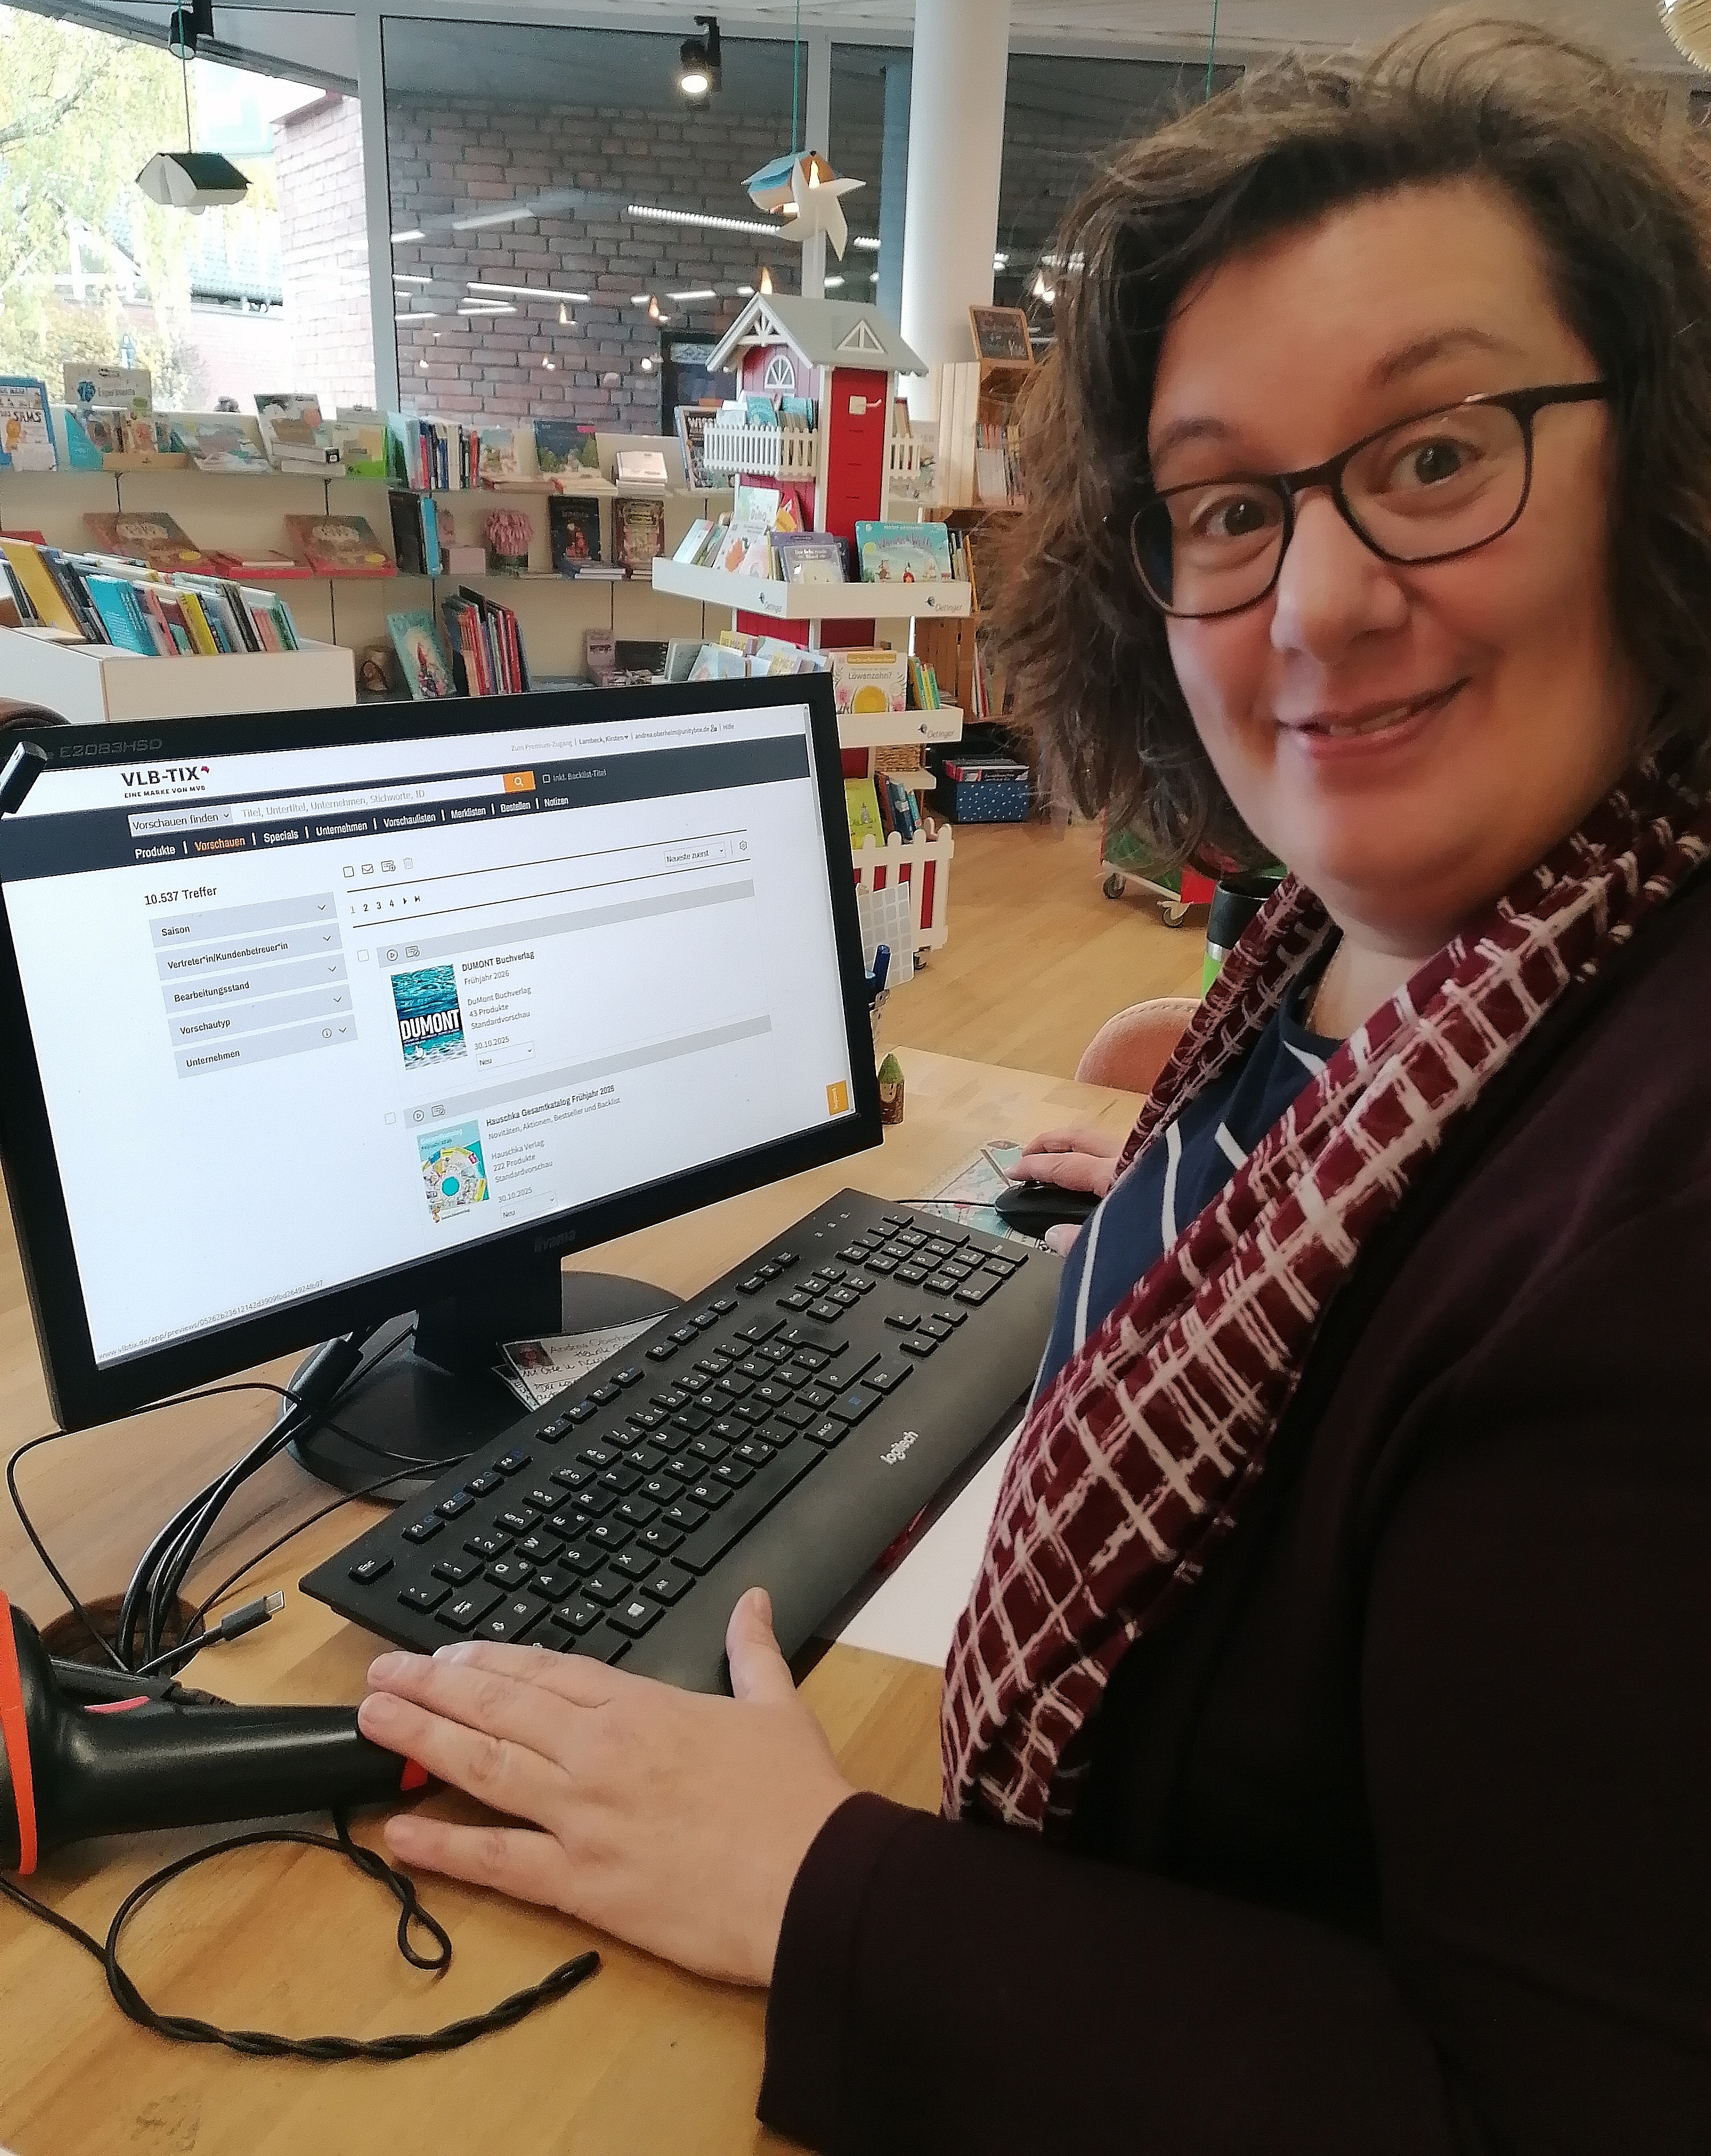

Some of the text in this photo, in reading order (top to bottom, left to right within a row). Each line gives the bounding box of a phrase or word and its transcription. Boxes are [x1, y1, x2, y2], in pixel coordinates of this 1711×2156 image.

[935, 603, 962, 612] Oetinger
[59, 738, 163, 758] E2083HSD
[121, 766, 200, 786] VLB-TIX
[242, 808, 263, 818] Titel,
[266, 803, 309, 815] Untertitel,
[311, 797, 368, 810] Unternehmen,
[370, 791, 413, 804] Stichworte,
[132, 813, 218, 830] Vorschauen finden
[135, 797, 569, 859] Produkte Vorschauen Specials Unternehmen Vorschaulisten Merklisten Bestellen Notizen
[144, 886, 217, 906] 10.537 Treffer
[363, 903, 368, 912] 2
[162, 925, 190, 936] Saison
[462, 951, 535, 972] DUMONT Buchverlag
[464, 971, 510, 985] Frühjahr 2026
[174, 981, 250, 1002] Bearbeitungsstand
[468, 987, 532, 1006] DuMont Buchverlag
[479, 1004, 509, 1016] Produkte
[400, 1009, 460, 1040] DUMONT
[471, 1010, 530, 1030] Standardvorschau
[180, 1018, 230, 1035] Vorschautyp
[475, 1036, 510, 1050] 30.10.2025
[186, 1050, 240, 1067] Unternehmen
[486, 1112, 521, 1126] Hauschka
[521, 1096, 571, 1116] Gesamtkatalog
[571, 1090, 599, 1105] Frühjahr
[489, 1125, 522, 1139] Novitäten,
[523, 1117, 553, 1130] Aktionen,
[554, 1109, 583, 1122] Bestseller
[492, 1139, 545, 1160] Hauschka Verlag
[506, 1154, 536, 1167] Produkte
[495, 1160, 553, 1183] Standardvorschau
[502, 1210, 516, 1219] Neu
[741, 1444, 753, 1454] M
[632, 1452, 644, 1461] Z
[672, 1461, 684, 1471] H
[718, 1465, 731, 1475] N
[648, 1482, 661, 1491] G
[695, 1487, 708, 1496] B
[580, 1494, 593, 1503] R
[670, 1508, 682, 1517] V
[553, 1516, 566, 1525] E
[647, 1530, 659, 1540] C
[524, 1537, 539, 1549] W
[568, 1550, 580, 1560] S
[619, 1554, 632, 1564] X
[540, 1576, 553, 1585] A
[590, 1579, 603, 1588] Y
